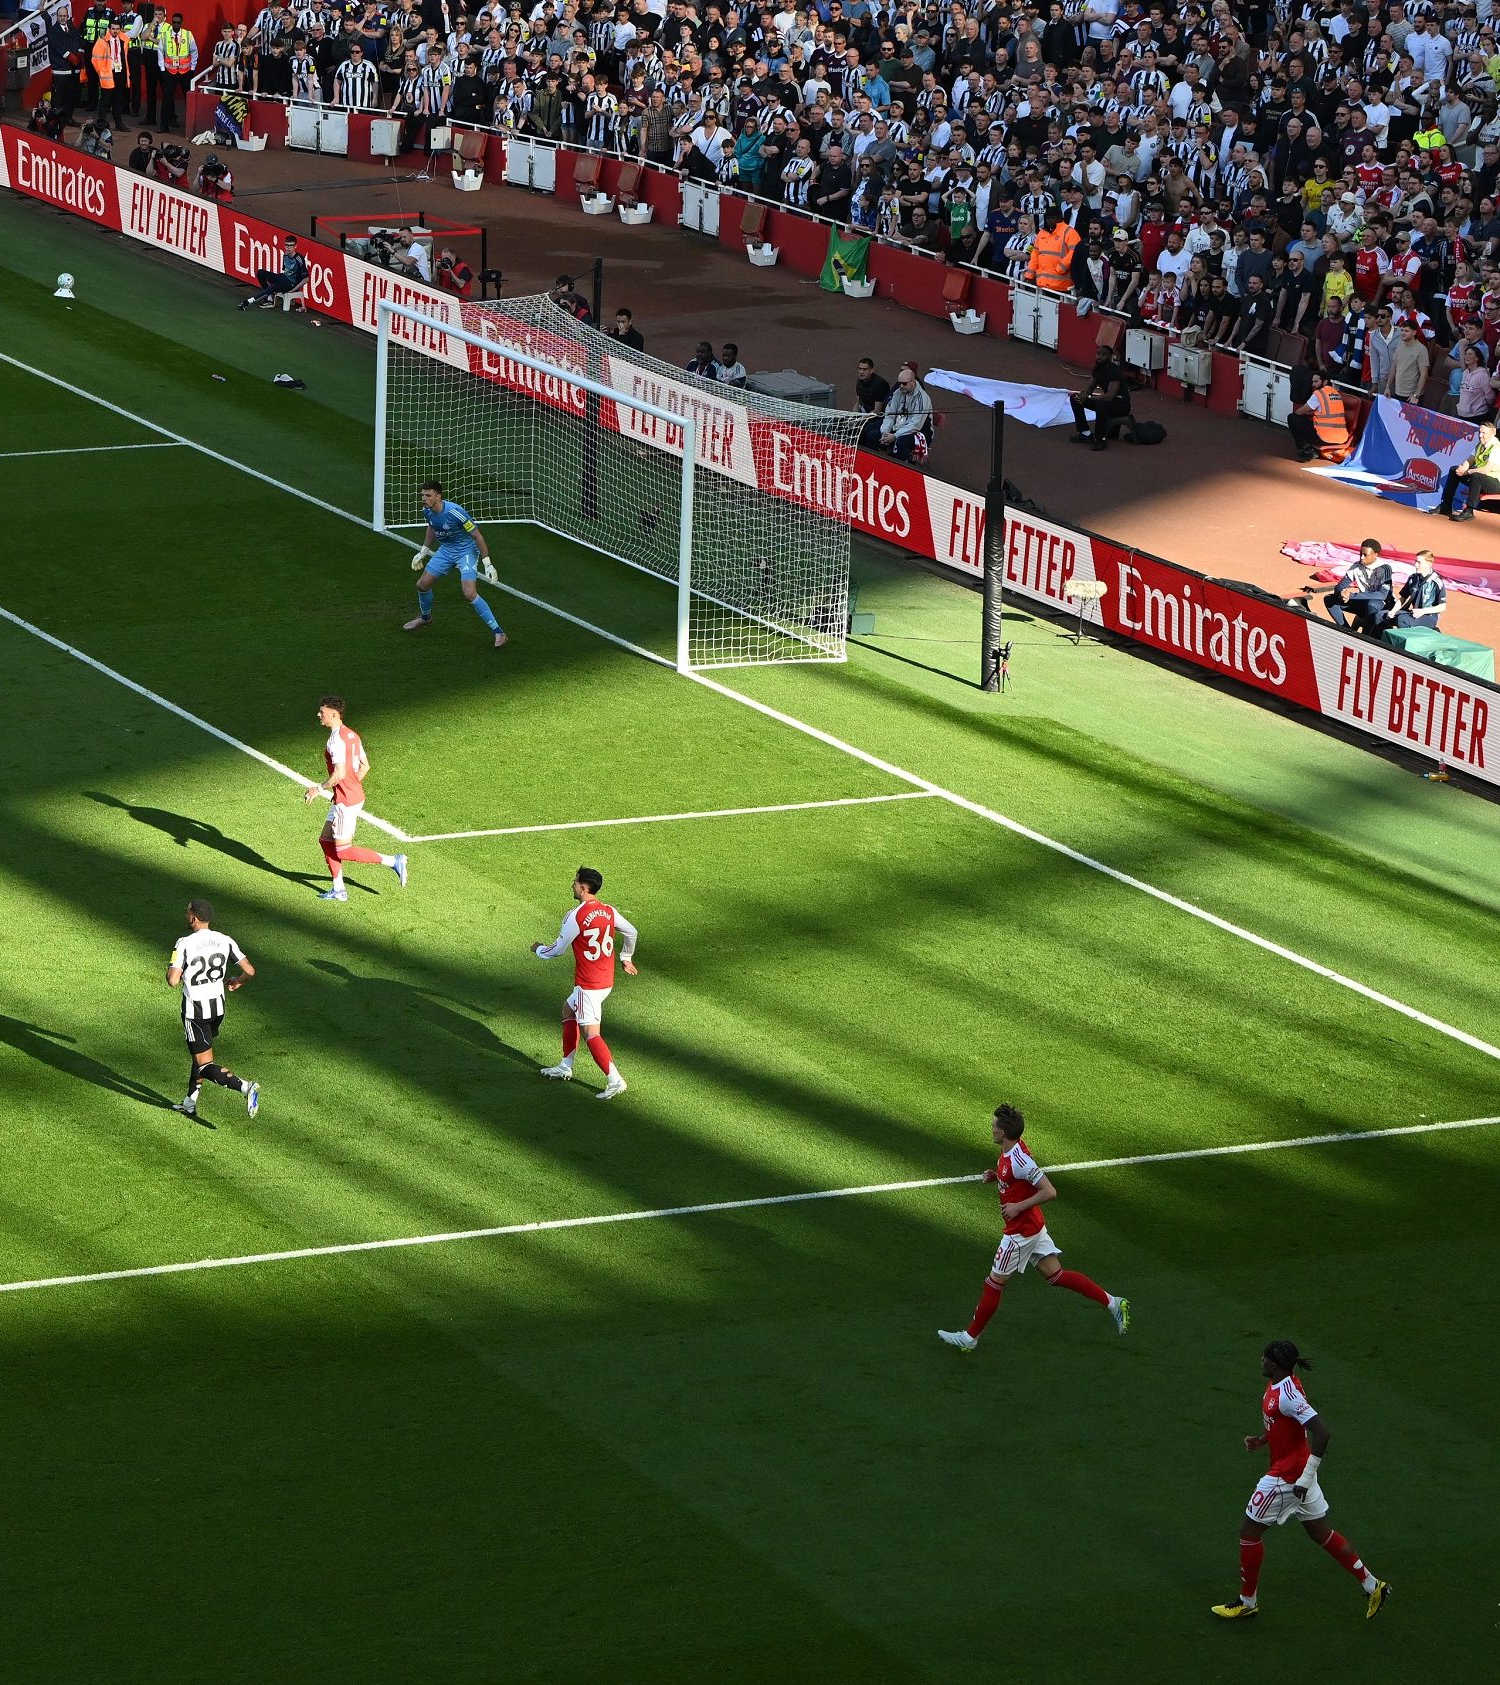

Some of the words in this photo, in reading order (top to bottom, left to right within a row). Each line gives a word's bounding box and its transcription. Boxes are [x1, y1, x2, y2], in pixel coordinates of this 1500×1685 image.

[17, 138, 105, 217] Emirates
[130, 182, 153, 235] FLY
[156, 191, 209, 258] BETTER
[631, 375, 662, 438] FLY
[772, 430, 910, 538] Emirates
[1408, 468, 1437, 488] Arsenal
[949, 498, 986, 567] FLY
[1003, 517, 1076, 605] ETTER
[1117, 561, 1287, 686] Emirates
[1337, 645, 1384, 724] FLY
[1387, 665, 1489, 769] BETTER
[191, 952, 226, 987] 28
[583, 924, 614, 961] 36
